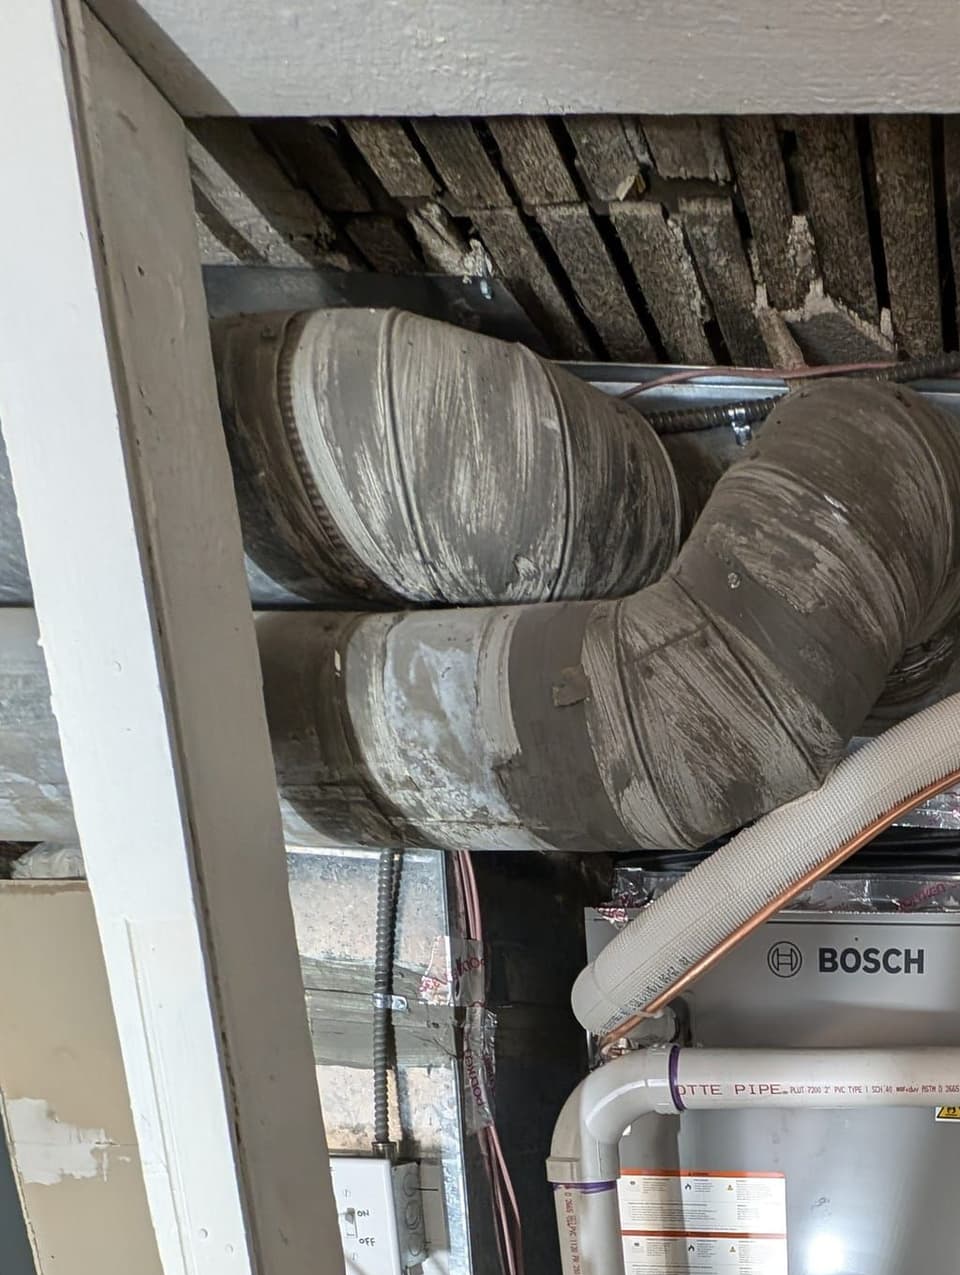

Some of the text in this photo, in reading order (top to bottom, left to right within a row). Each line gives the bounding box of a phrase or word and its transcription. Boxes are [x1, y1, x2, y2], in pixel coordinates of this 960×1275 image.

[818, 947, 925, 974] BOSCH
[735, 1084, 783, 1095] PIPE
[834, 1086, 846, 1094] PVC
[848, 1086, 862, 1094] TYPE
[359, 1237, 376, 1247] OFF
